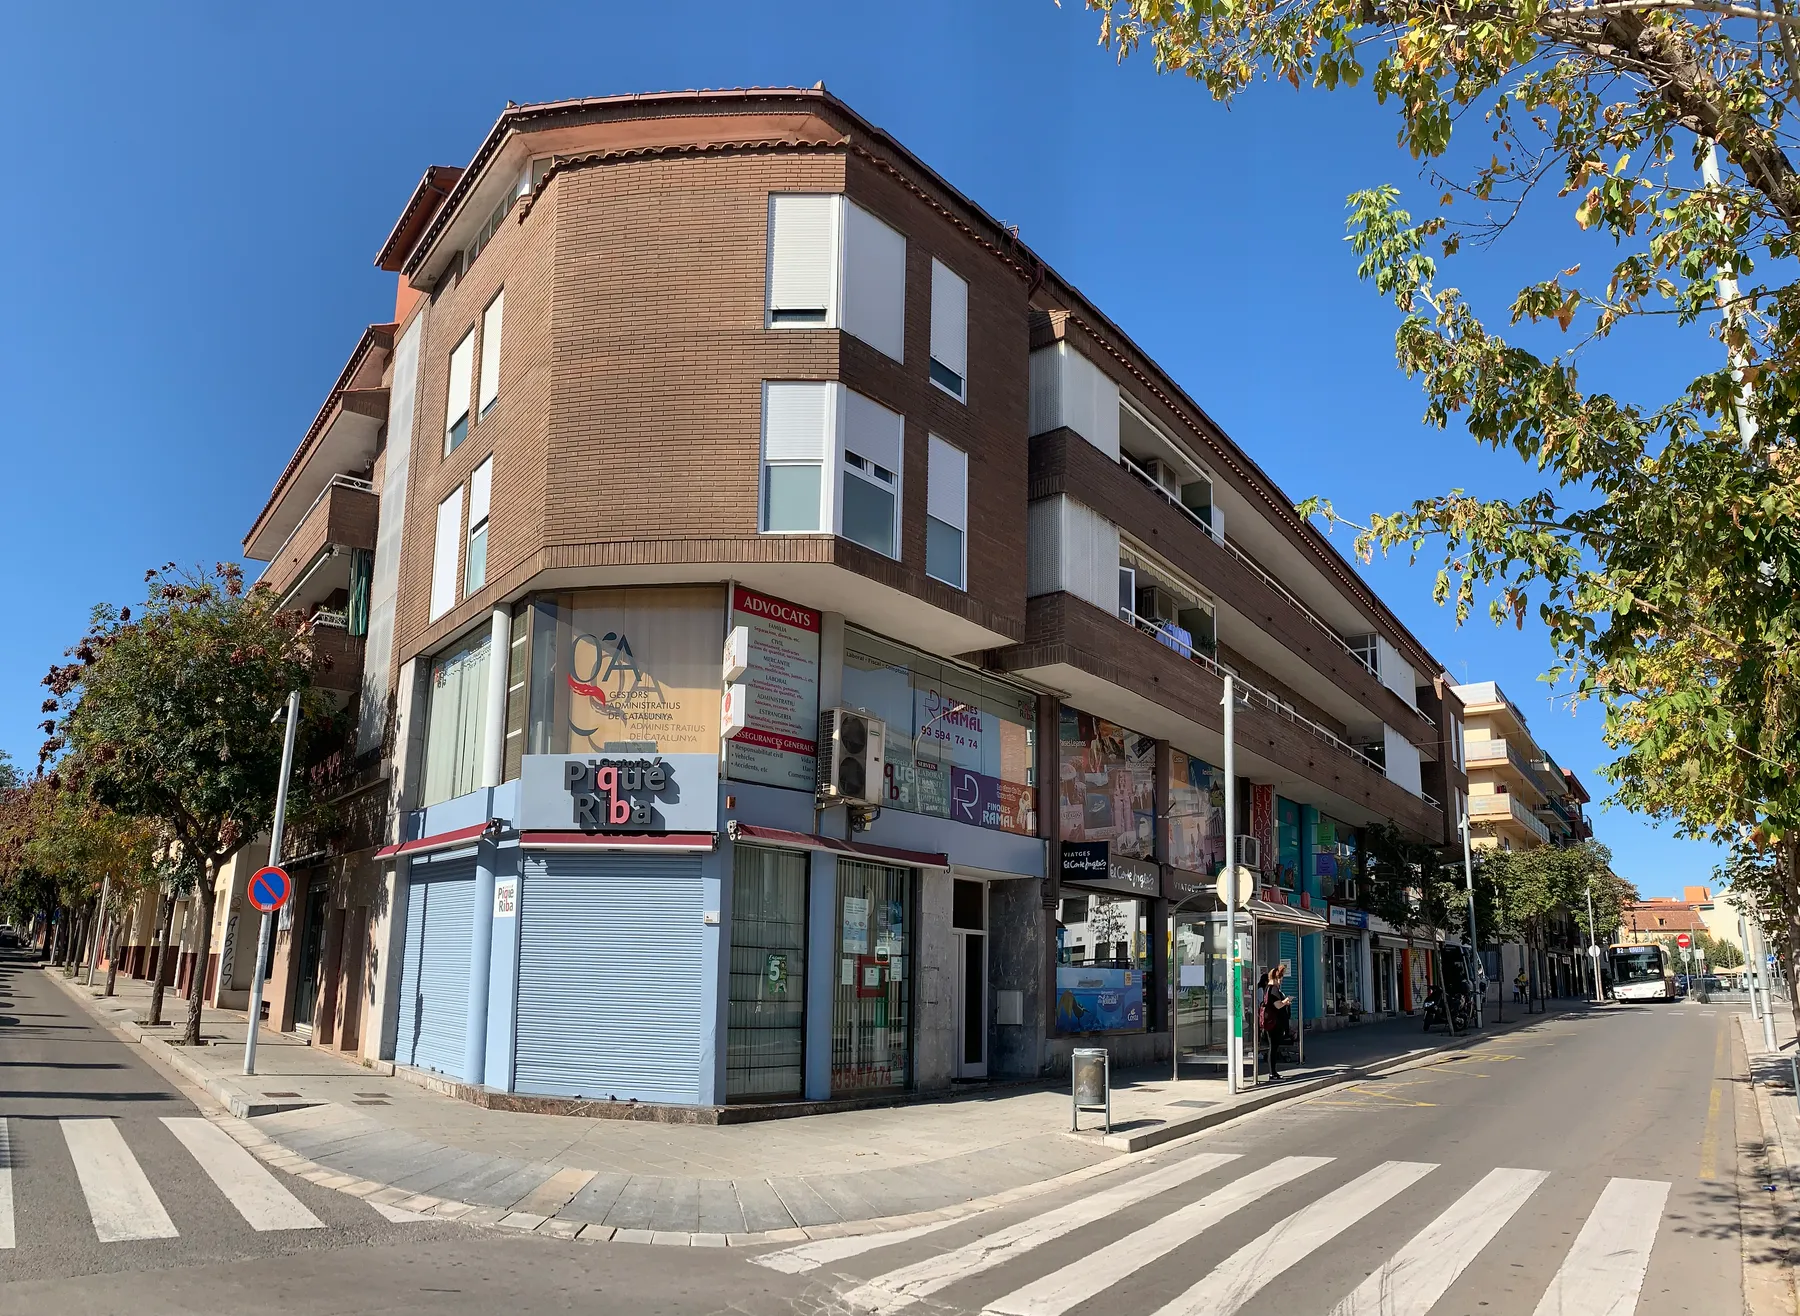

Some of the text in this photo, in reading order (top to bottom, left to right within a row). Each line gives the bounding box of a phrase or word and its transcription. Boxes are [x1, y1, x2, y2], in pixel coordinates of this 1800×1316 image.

[744, 596, 810, 626] ADVOCATS
[765, 675, 787, 685] LABORAL
[609, 690, 649, 699] GESTORS
[757, 693, 796, 707] ADMINISTRATIU
[608, 701, 681, 710] ADMINISTRATIUS
[608, 713, 620, 721] DE
[759, 708, 792, 721] ESTRANGERIA
[942, 706, 983, 733] RAMAL
[921, 726, 978, 750] 93 594 74 74
[735, 744, 784, 759] Responsabilitat civil
[784, 739, 815, 753] GENERALS
[735, 753, 755, 762] Vehicles
[734, 761, 760, 772] Accidents,
[564, 757, 666, 796] Piqué
[573, 791, 652, 824] Riba
[987, 802, 1011, 814] FINQUES
[982, 810, 1015, 828] RAMAL
[1063, 850, 1091, 858] VIATGES
[1063, 857, 1107, 871] El Corte Inglés
[1110, 863, 1155, 888] El Corte Inglés
[498, 885, 514, 900] Piqué
[499, 899, 514, 912] Riba
[769, 960, 780, 981] 5
[879, 1064, 892, 1085] 74
